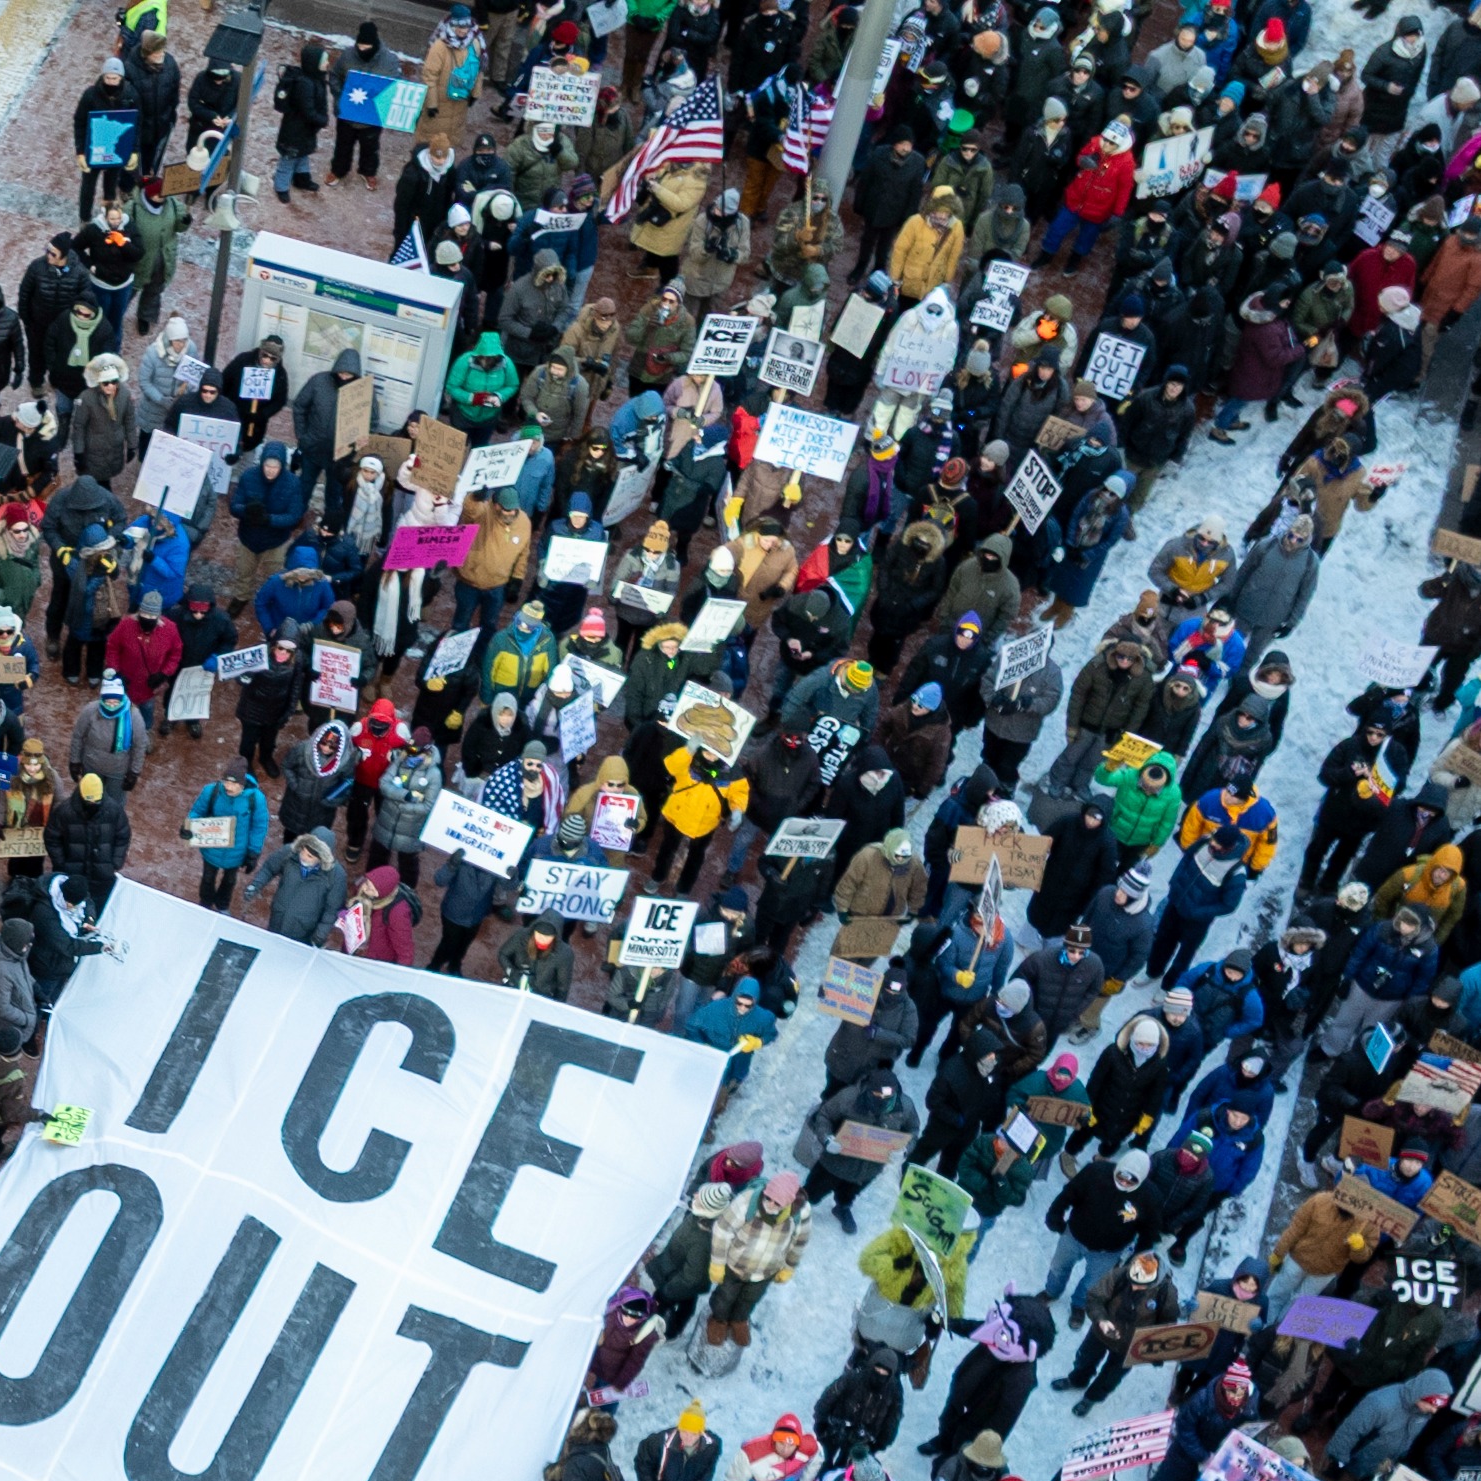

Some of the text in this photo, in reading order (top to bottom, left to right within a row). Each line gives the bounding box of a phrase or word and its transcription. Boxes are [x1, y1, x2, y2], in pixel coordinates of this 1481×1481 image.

[392, 83, 425, 107] ICE
[385, 103, 417, 130] OUT
[273, 275, 309, 289] METRO
[993, 264, 1025, 281] RESPECT
[708, 318, 753, 331] PROTESTING
[975, 306, 1010, 326] PEOPLE
[703, 330, 749, 344] ICE
[1098, 338, 1143, 365] GET
[892, 368, 939, 392] LOVE
[1094, 355, 1140, 380] OUT
[1090, 369, 1132, 398] ICE
[778, 409, 844, 436] MINNESOTA
[773, 424, 835, 448] NICE DOES
[769, 437, 794, 453] NOT
[829, 448, 848, 462] TO
[777, 451, 823, 474] ICE
[1024, 456, 1056, 501] STOP
[172, 690, 211, 718] OUT
[452, 801, 476, 818] THIS
[493, 820, 514, 835] NOT
[445, 828, 505, 859] IMMIGRATION
[463, 822, 495, 842] ABOUT
[985, 831, 1023, 851] FUCK
[545, 867, 610, 889] STAY
[522, 888, 616, 918] STRONG
[645, 903, 682, 931] ICE
[627, 943, 679, 959] MINNESOTA
[630, 935, 683, 945] OUT OF
[66, 1107, 90, 1142] HANDS
[127, 939, 644, 1292] ICE
[1369, 1210, 1403, 1239] ICE
[1395, 1256, 1458, 1283] ICE
[1211, 1297, 1242, 1314] ICE
[1392, 1280, 1460, 1308] OUT
[1142, 1333, 1204, 1354] ICE
